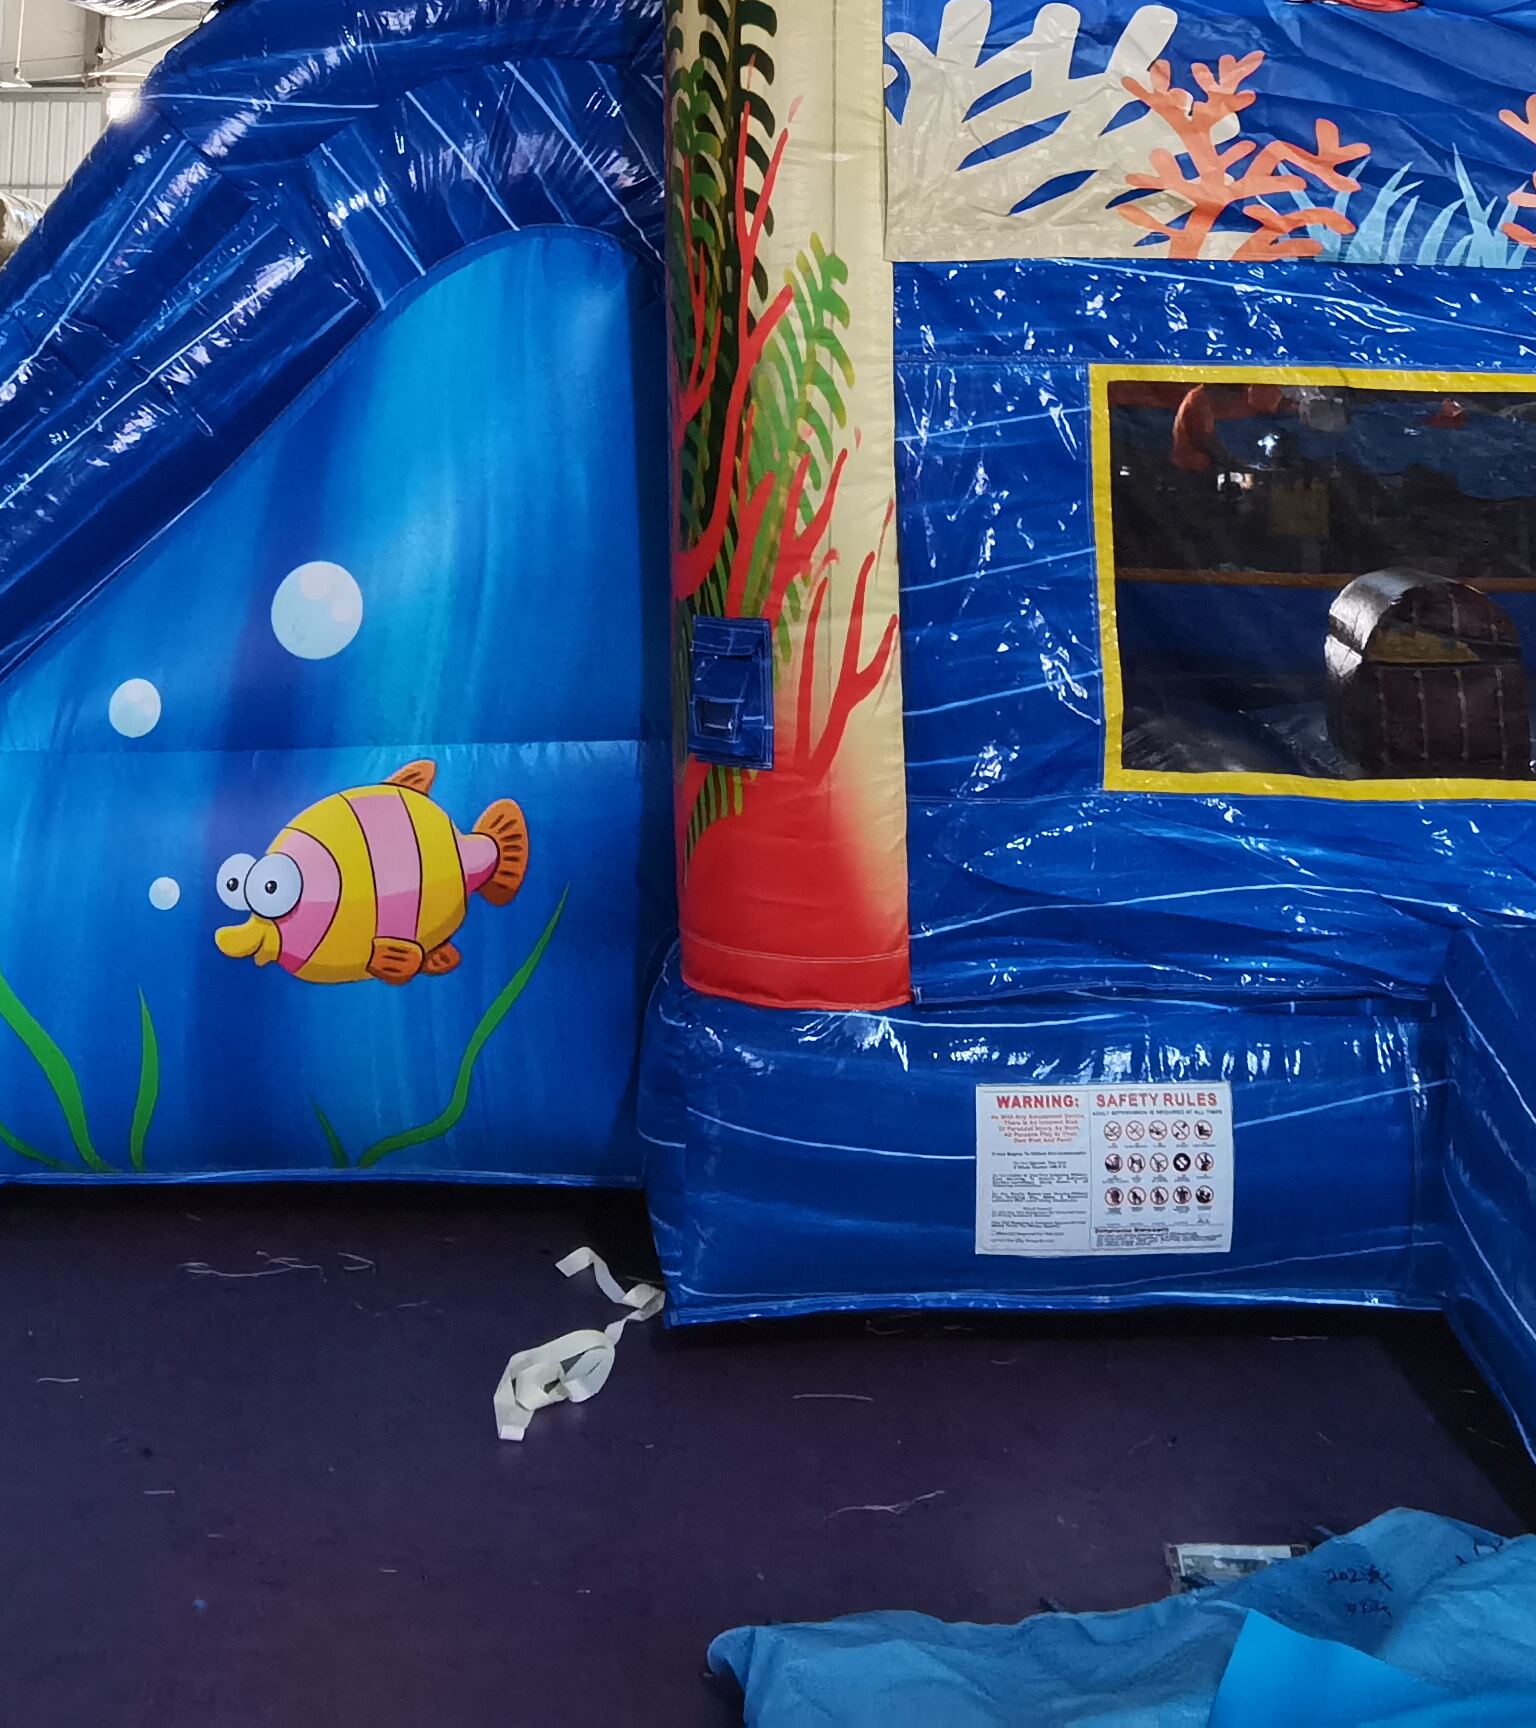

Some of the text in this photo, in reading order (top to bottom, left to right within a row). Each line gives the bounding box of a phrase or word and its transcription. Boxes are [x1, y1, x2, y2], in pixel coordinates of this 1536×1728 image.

[996, 1094, 1080, 1110] WARNING:
[1096, 1092, 1218, 1108] SAFETY RULES
